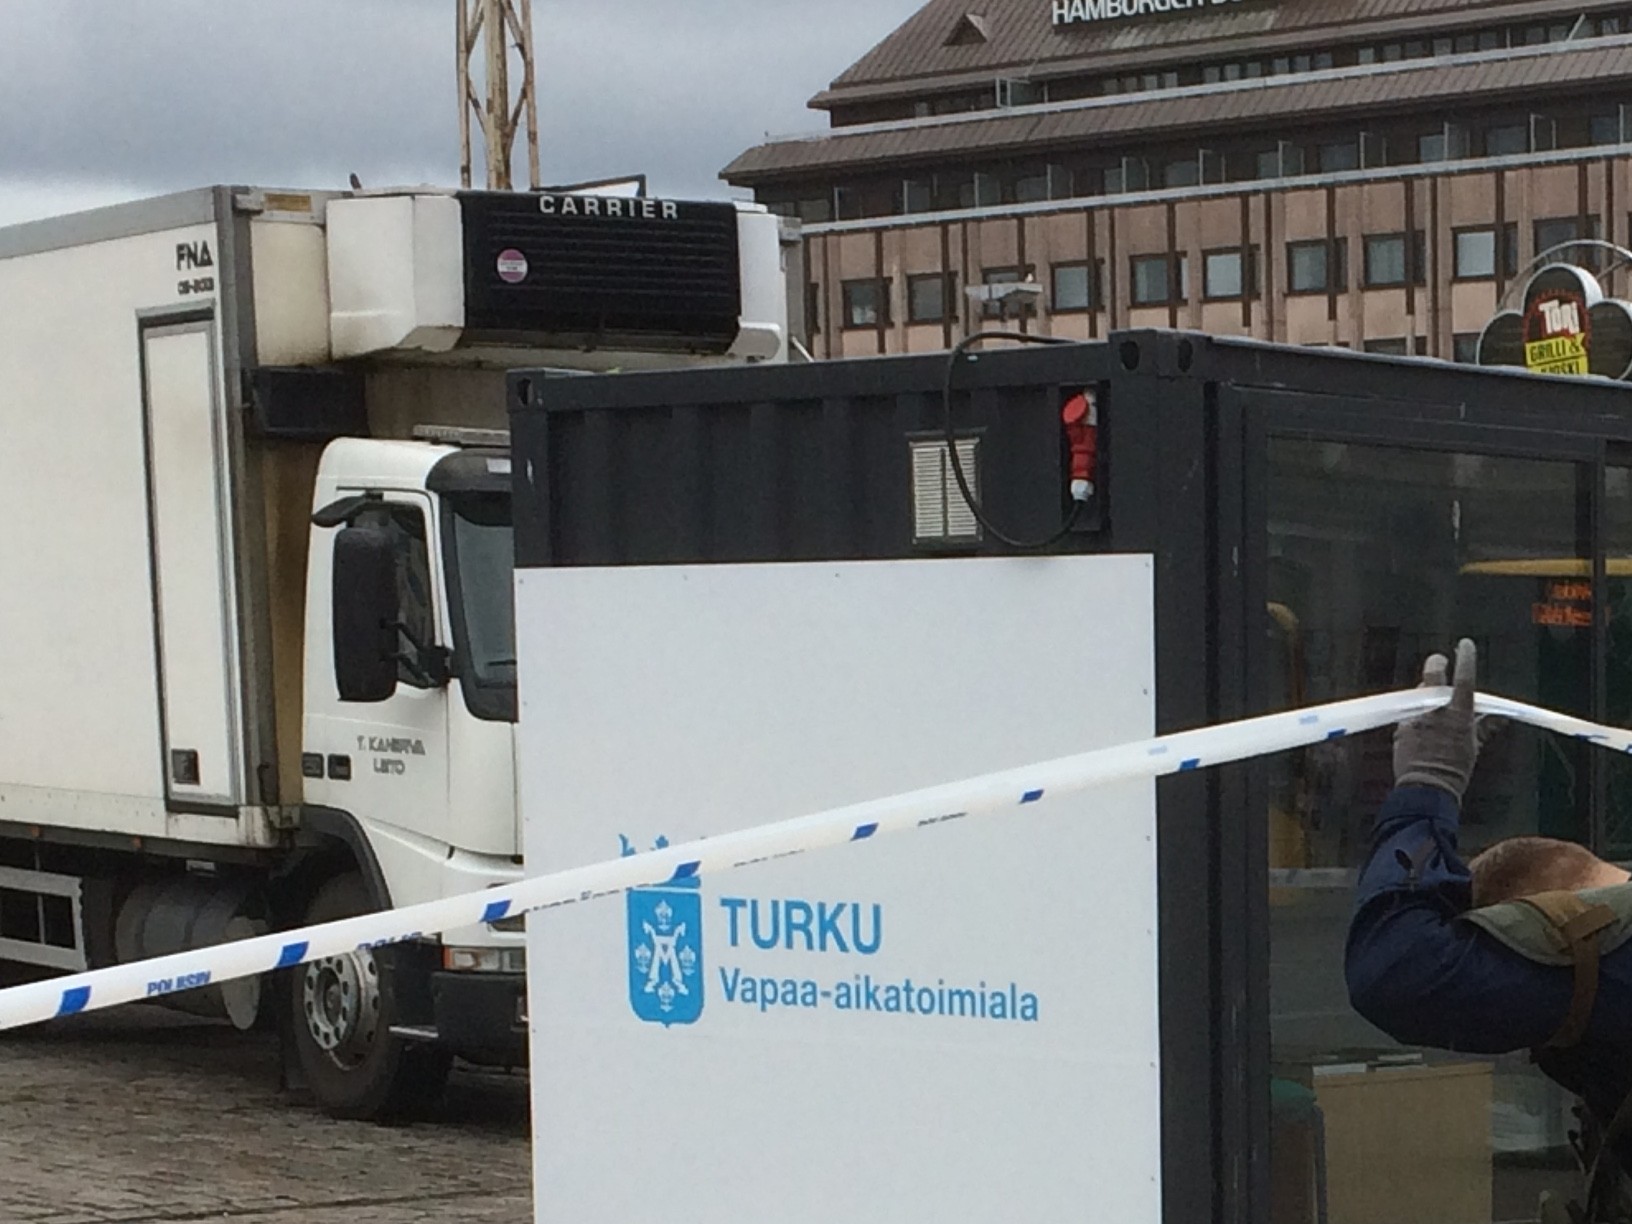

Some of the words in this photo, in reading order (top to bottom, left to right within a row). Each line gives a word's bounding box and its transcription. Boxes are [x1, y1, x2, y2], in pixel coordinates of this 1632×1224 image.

[539, 196, 678, 219] CARRIER
[719, 896, 883, 955] TURKU
[719, 966, 1039, 1022] Vapaa-aikatoimiala
